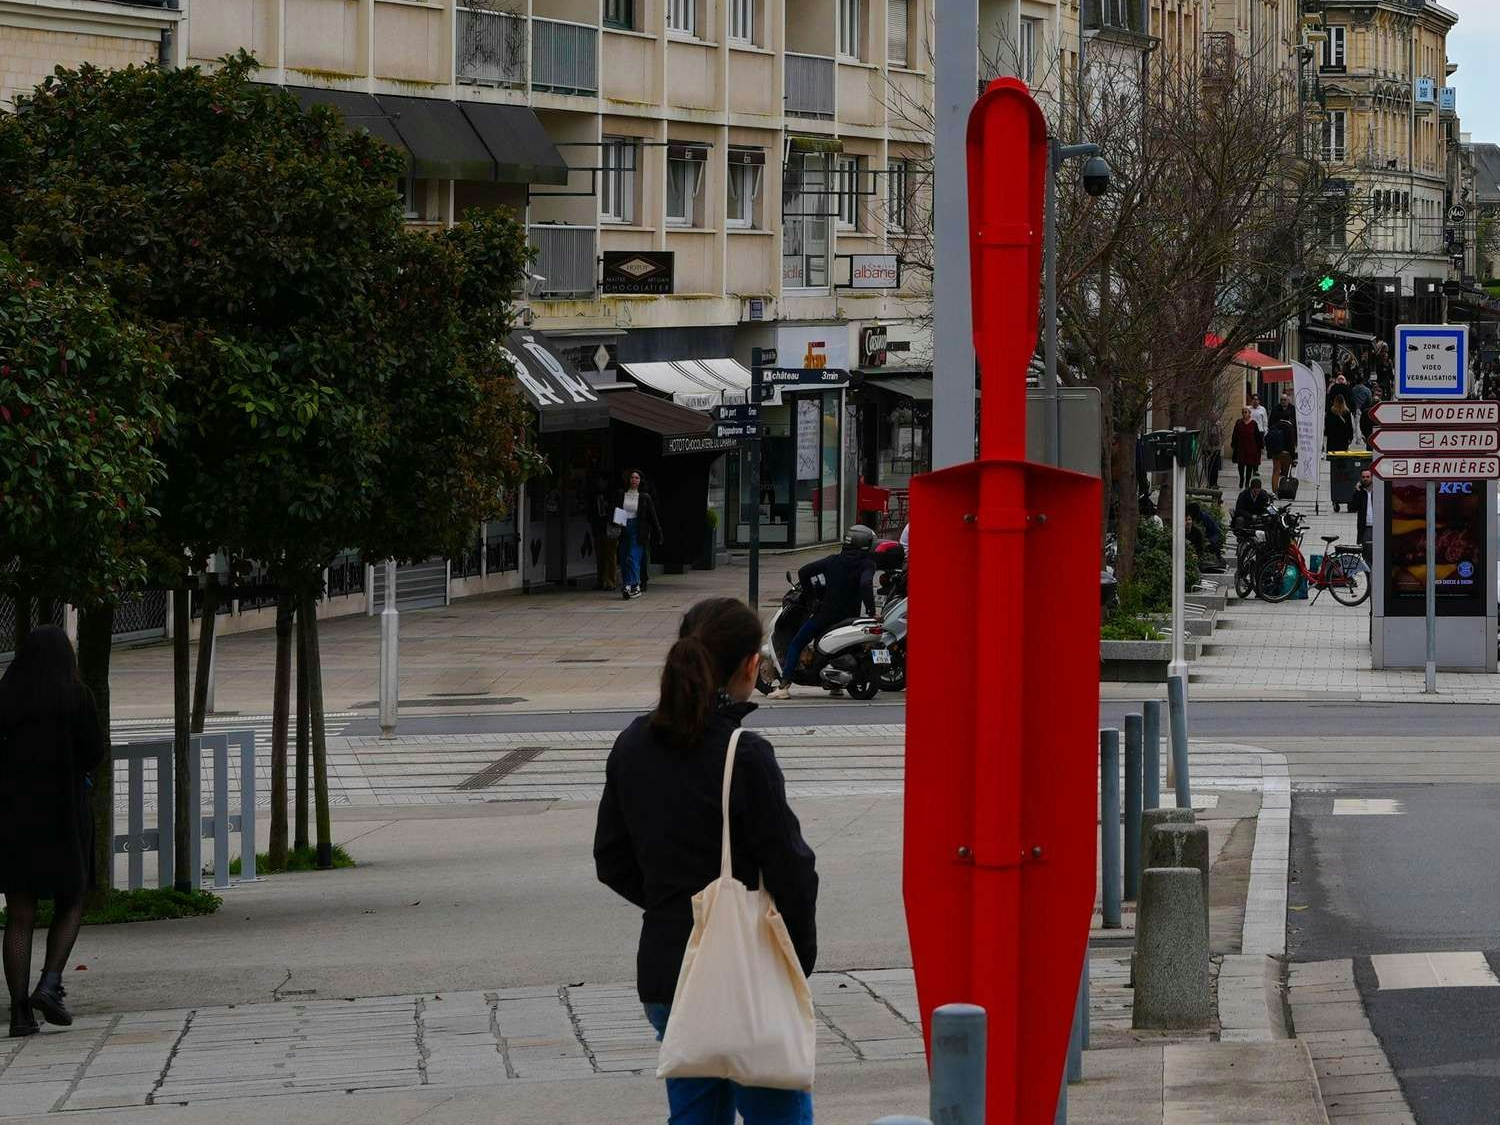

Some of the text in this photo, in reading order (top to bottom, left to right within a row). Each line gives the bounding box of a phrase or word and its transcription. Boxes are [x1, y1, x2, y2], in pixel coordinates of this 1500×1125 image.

[854, 266, 896, 279] albane
[605, 284, 670, 292] CHOCOLATIER
[772, 369, 799, 380] château
[1421, 407, 1495, 420] MODERNE
[1439, 435, 1495, 447] ASTRID
[1412, 459, 1496, 474] BERNIÈRES
[1438, 481, 1473, 494] KFC
